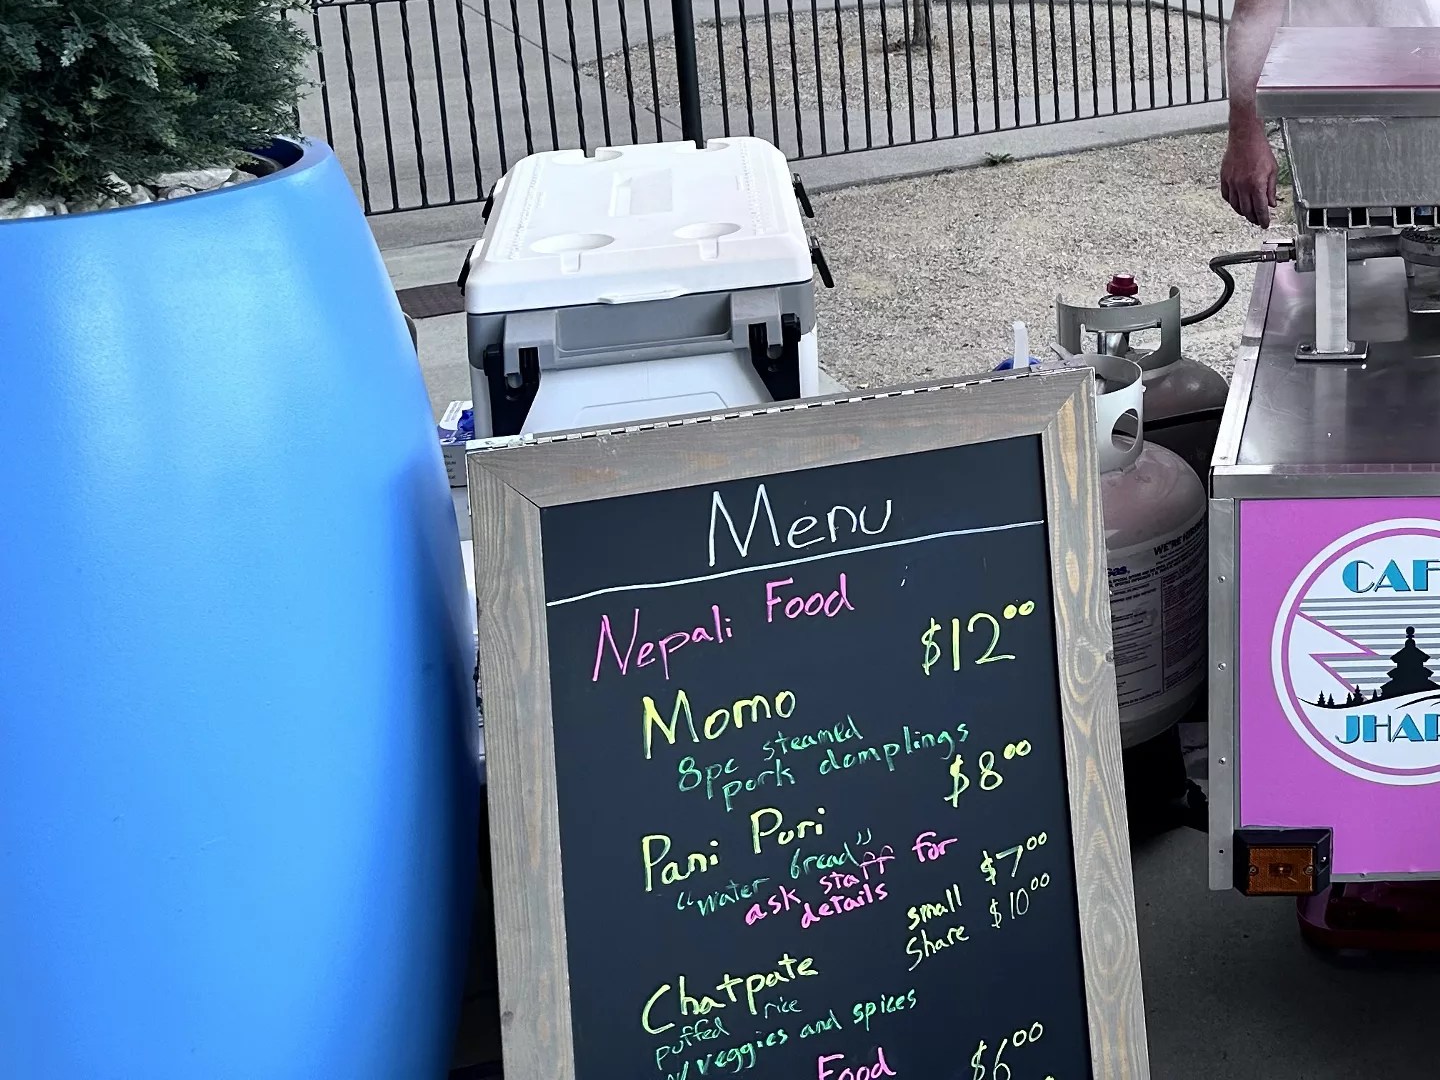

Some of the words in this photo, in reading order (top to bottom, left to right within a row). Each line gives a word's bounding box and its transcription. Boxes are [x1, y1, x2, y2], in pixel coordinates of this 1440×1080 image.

[708, 484, 892, 566] Menu
[592, 607, 733, 682] Nepali
[766, 573, 856, 622] Food
[642, 688, 797, 760] Momo
[678, 756, 739, 800] 8pc
[763, 715, 865, 758] steamed
[723, 766, 796, 812] pork
[642, 833, 720, 893] Pani
[745, 889, 802, 925] ask
[820, 845, 896, 894] staff
[911, 831, 959, 864] for
[801, 884, 890, 929] details
[907, 884, 964, 930] small
[642, 952, 819, 1035] Chatpate
[696, 1028, 789, 1074] veggies
[799, 1010, 841, 1038] and
[854, 988, 917, 1025] spices
[656, 1017, 731, 1071] puffed
[764, 997, 803, 1019] rice
